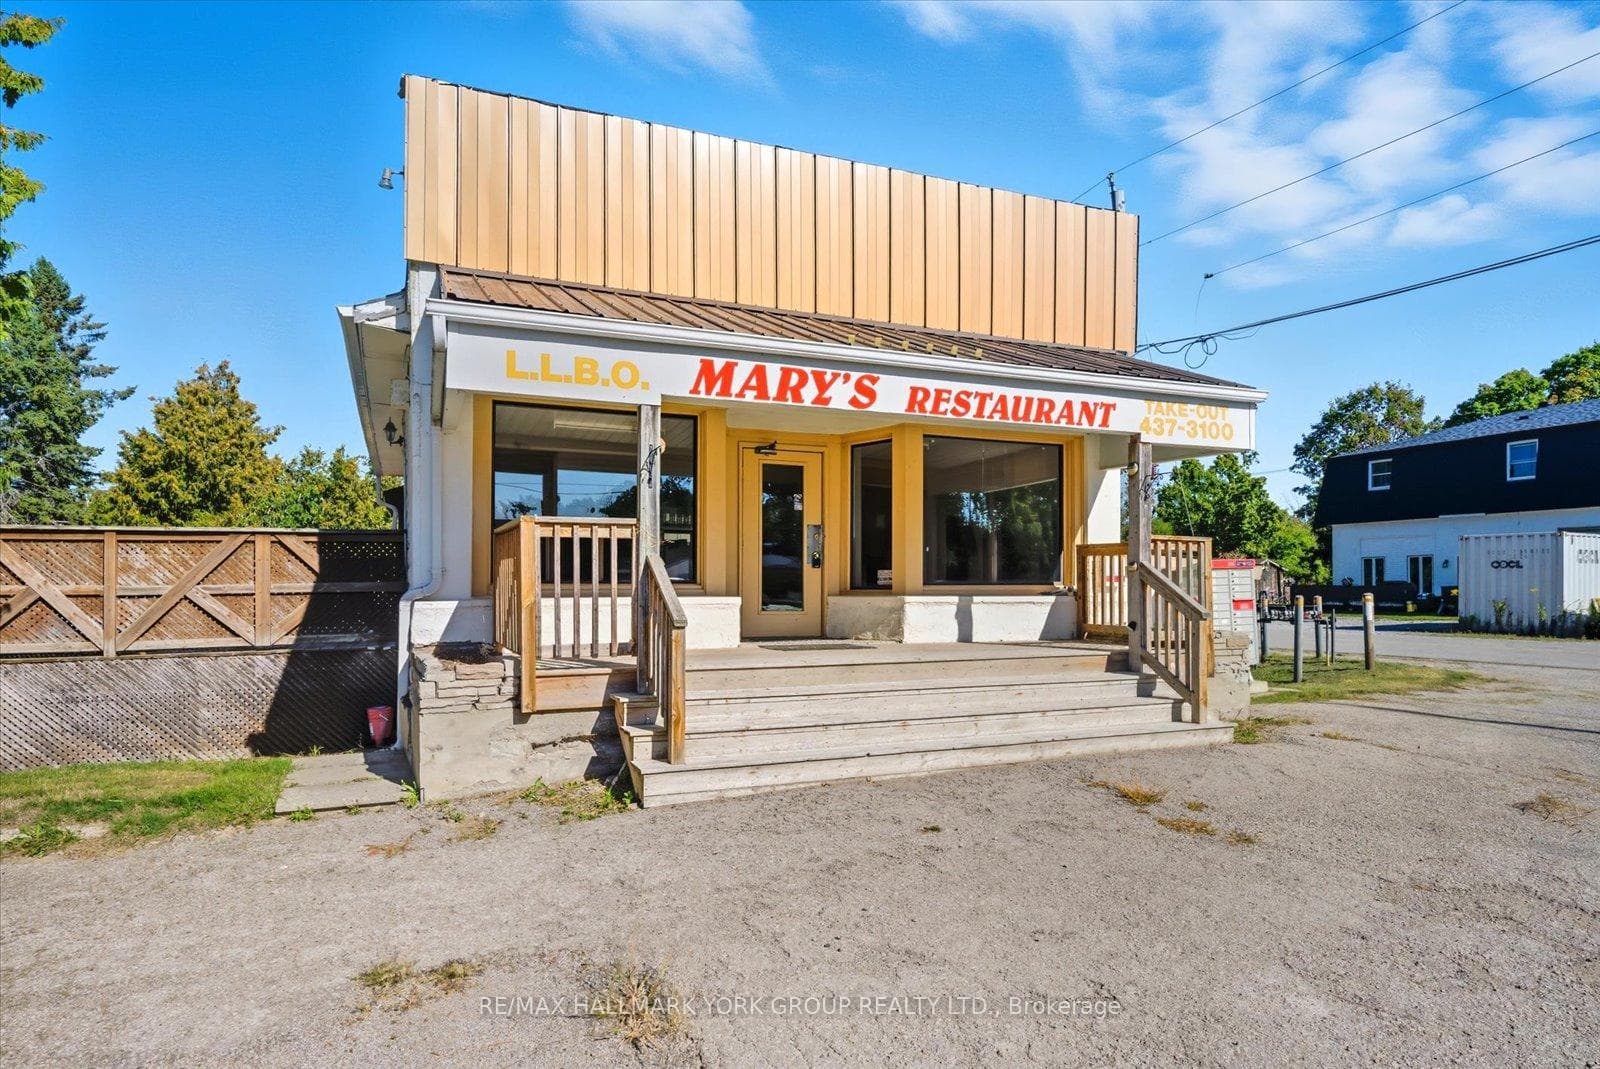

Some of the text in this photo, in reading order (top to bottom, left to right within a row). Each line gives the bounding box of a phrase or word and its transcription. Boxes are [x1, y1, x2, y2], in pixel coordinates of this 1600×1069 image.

[505, 349, 650, 391] L.L.B.O.
[689, 357, 1117, 429] MARY'S RESTAURANT
[1144, 398, 1229, 421] TAKE-OUT
[1140, 416, 1234, 441] 437-3100
